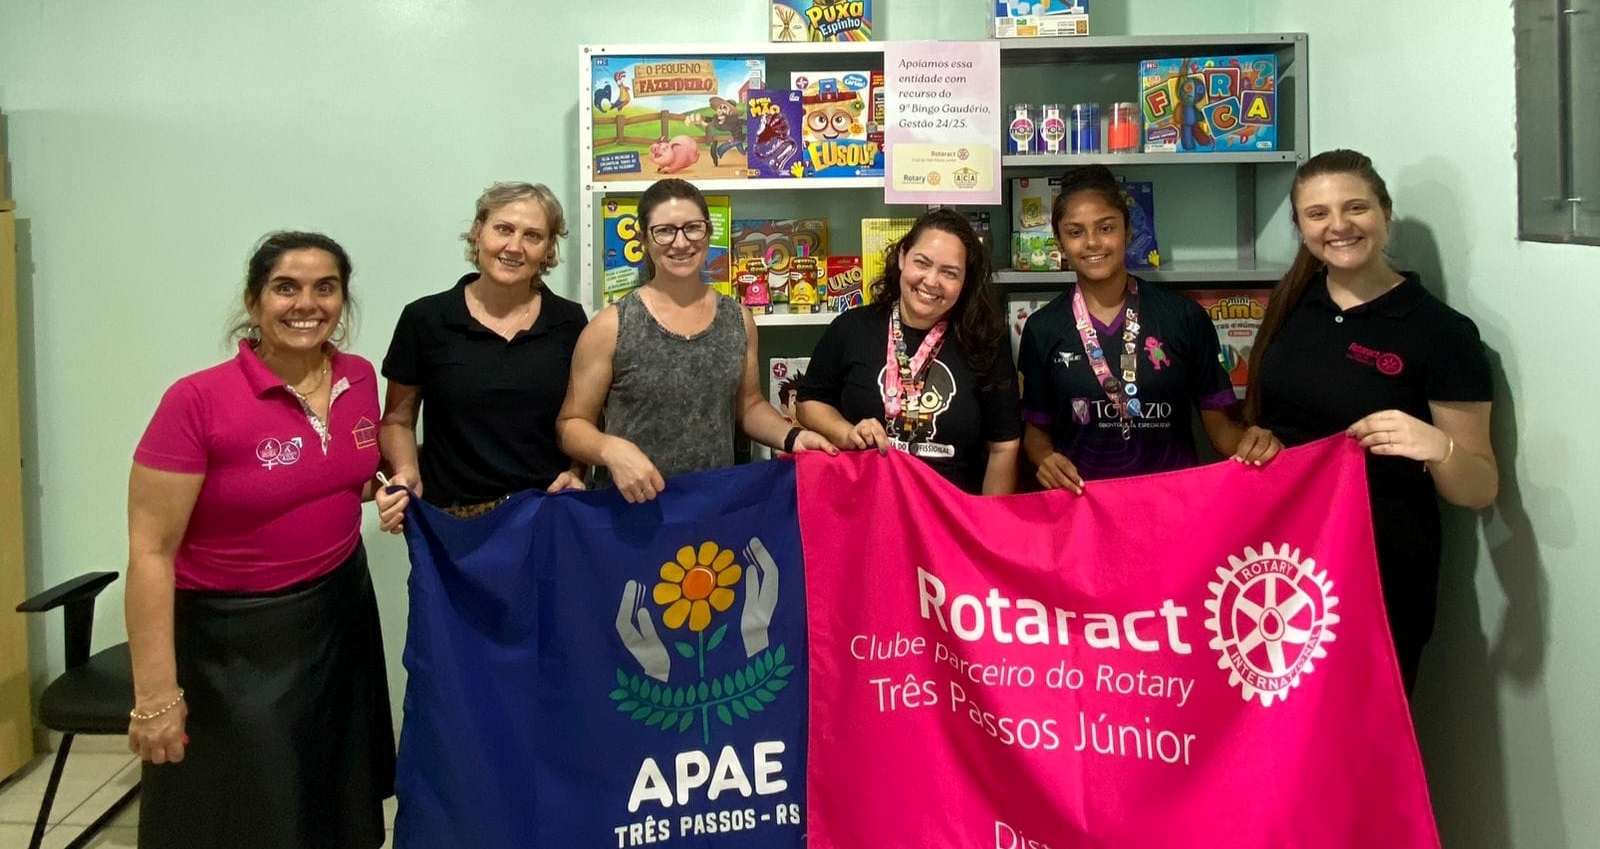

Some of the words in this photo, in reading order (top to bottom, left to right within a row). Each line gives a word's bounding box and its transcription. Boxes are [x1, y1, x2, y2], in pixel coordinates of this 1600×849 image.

[806, 2, 863, 28] Puxa
[819, 18, 861, 36] Espinho
[646, 65, 653, 75] O
[655, 63, 701, 74] PEQUENO
[899, 59, 949, 70] Apoiamos
[639, 77, 714, 94] FAZENDEIRO
[899, 74, 943, 83] entidade
[939, 89, 952, 98] do
[912, 104, 940, 115] Bingo
[942, 104, 991, 114] Gaudério,
[899, 119, 934, 128] Gestão
[903, 174, 926, 184] Rotary
[827, 265, 863, 291] UNO
[1228, 295, 1249, 304] mini
[1241, 560, 1294, 582] ROTARY
[917, 567, 1193, 655] Rotaract
[1230, 629, 1321, 691] INTERNATIONAL
[850, 632, 926, 660] Clube
[934, 641, 1036, 688] parceiro
[1045, 660, 1084, 690] do
[1096, 664, 1195, 707] Rotary
[870, 674, 938, 713] Três
[950, 680, 1060, 751] Passos
[1074, 711, 1196, 766] Júnior
[627, 740, 788, 813] APAE
[614, 815, 671, 849] TRÊS
[680, 808, 756, 838] PASSOS
[776, 803, 800, 826] RS
